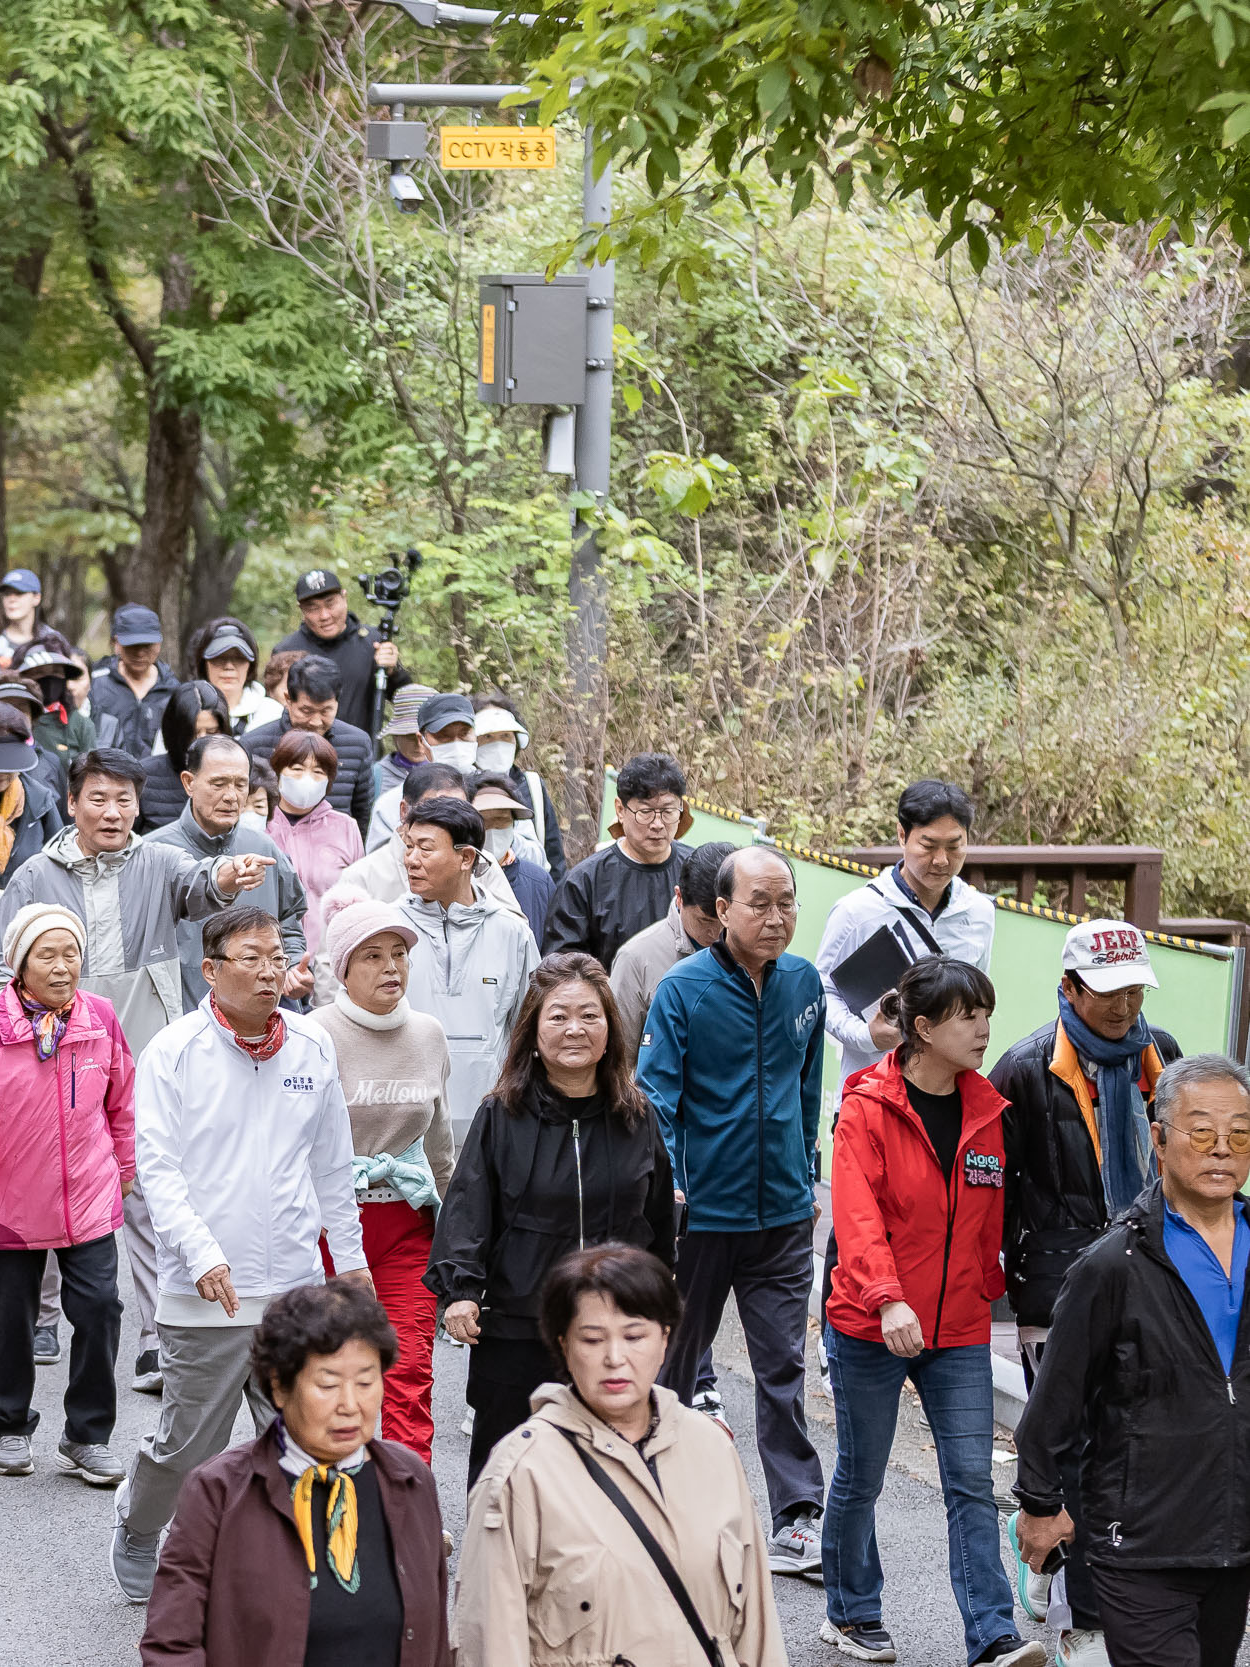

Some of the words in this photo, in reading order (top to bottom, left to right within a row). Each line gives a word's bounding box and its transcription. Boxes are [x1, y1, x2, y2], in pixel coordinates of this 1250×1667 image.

[449, 142, 495, 158] CCTV
[1091, 930, 1138, 952] JEEP
[1106, 951, 1142, 964] Spirit
[347, 1080, 430, 1105] Mellow
